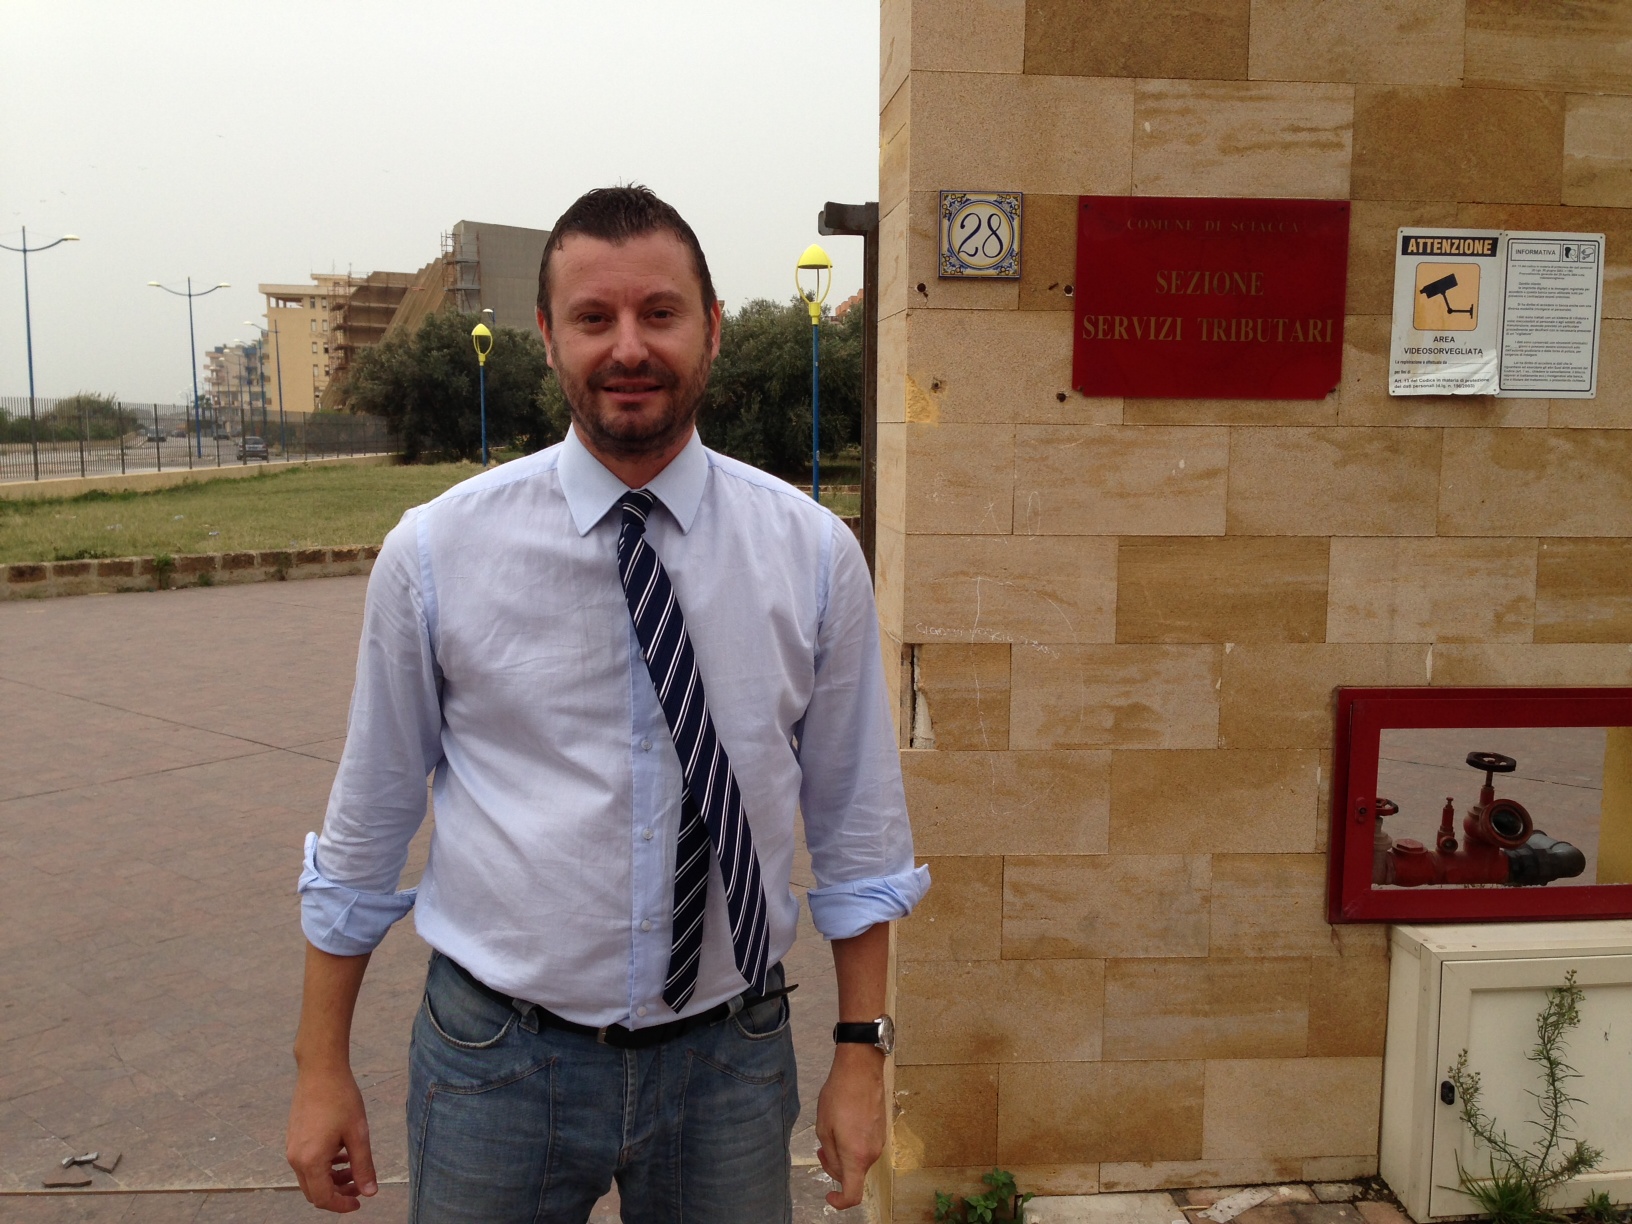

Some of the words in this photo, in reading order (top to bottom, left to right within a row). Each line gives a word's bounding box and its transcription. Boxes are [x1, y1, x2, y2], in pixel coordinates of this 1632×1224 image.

[958, 212, 1004, 259] 28
[1127, 218, 1194, 232] COMUNE
[1205, 220, 1222, 232] DI
[1231, 220, 1300, 233] SCIACCA
[1407, 238, 1493, 255] ATTENZIONE
[1156, 270, 1265, 295] SEZIONE
[1082, 314, 1184, 341] SERVIZI
[1197, 317, 1334, 343] TRIBUTARI
[1403, 347, 1484, 355] VIDEOSORVEGLIATA
